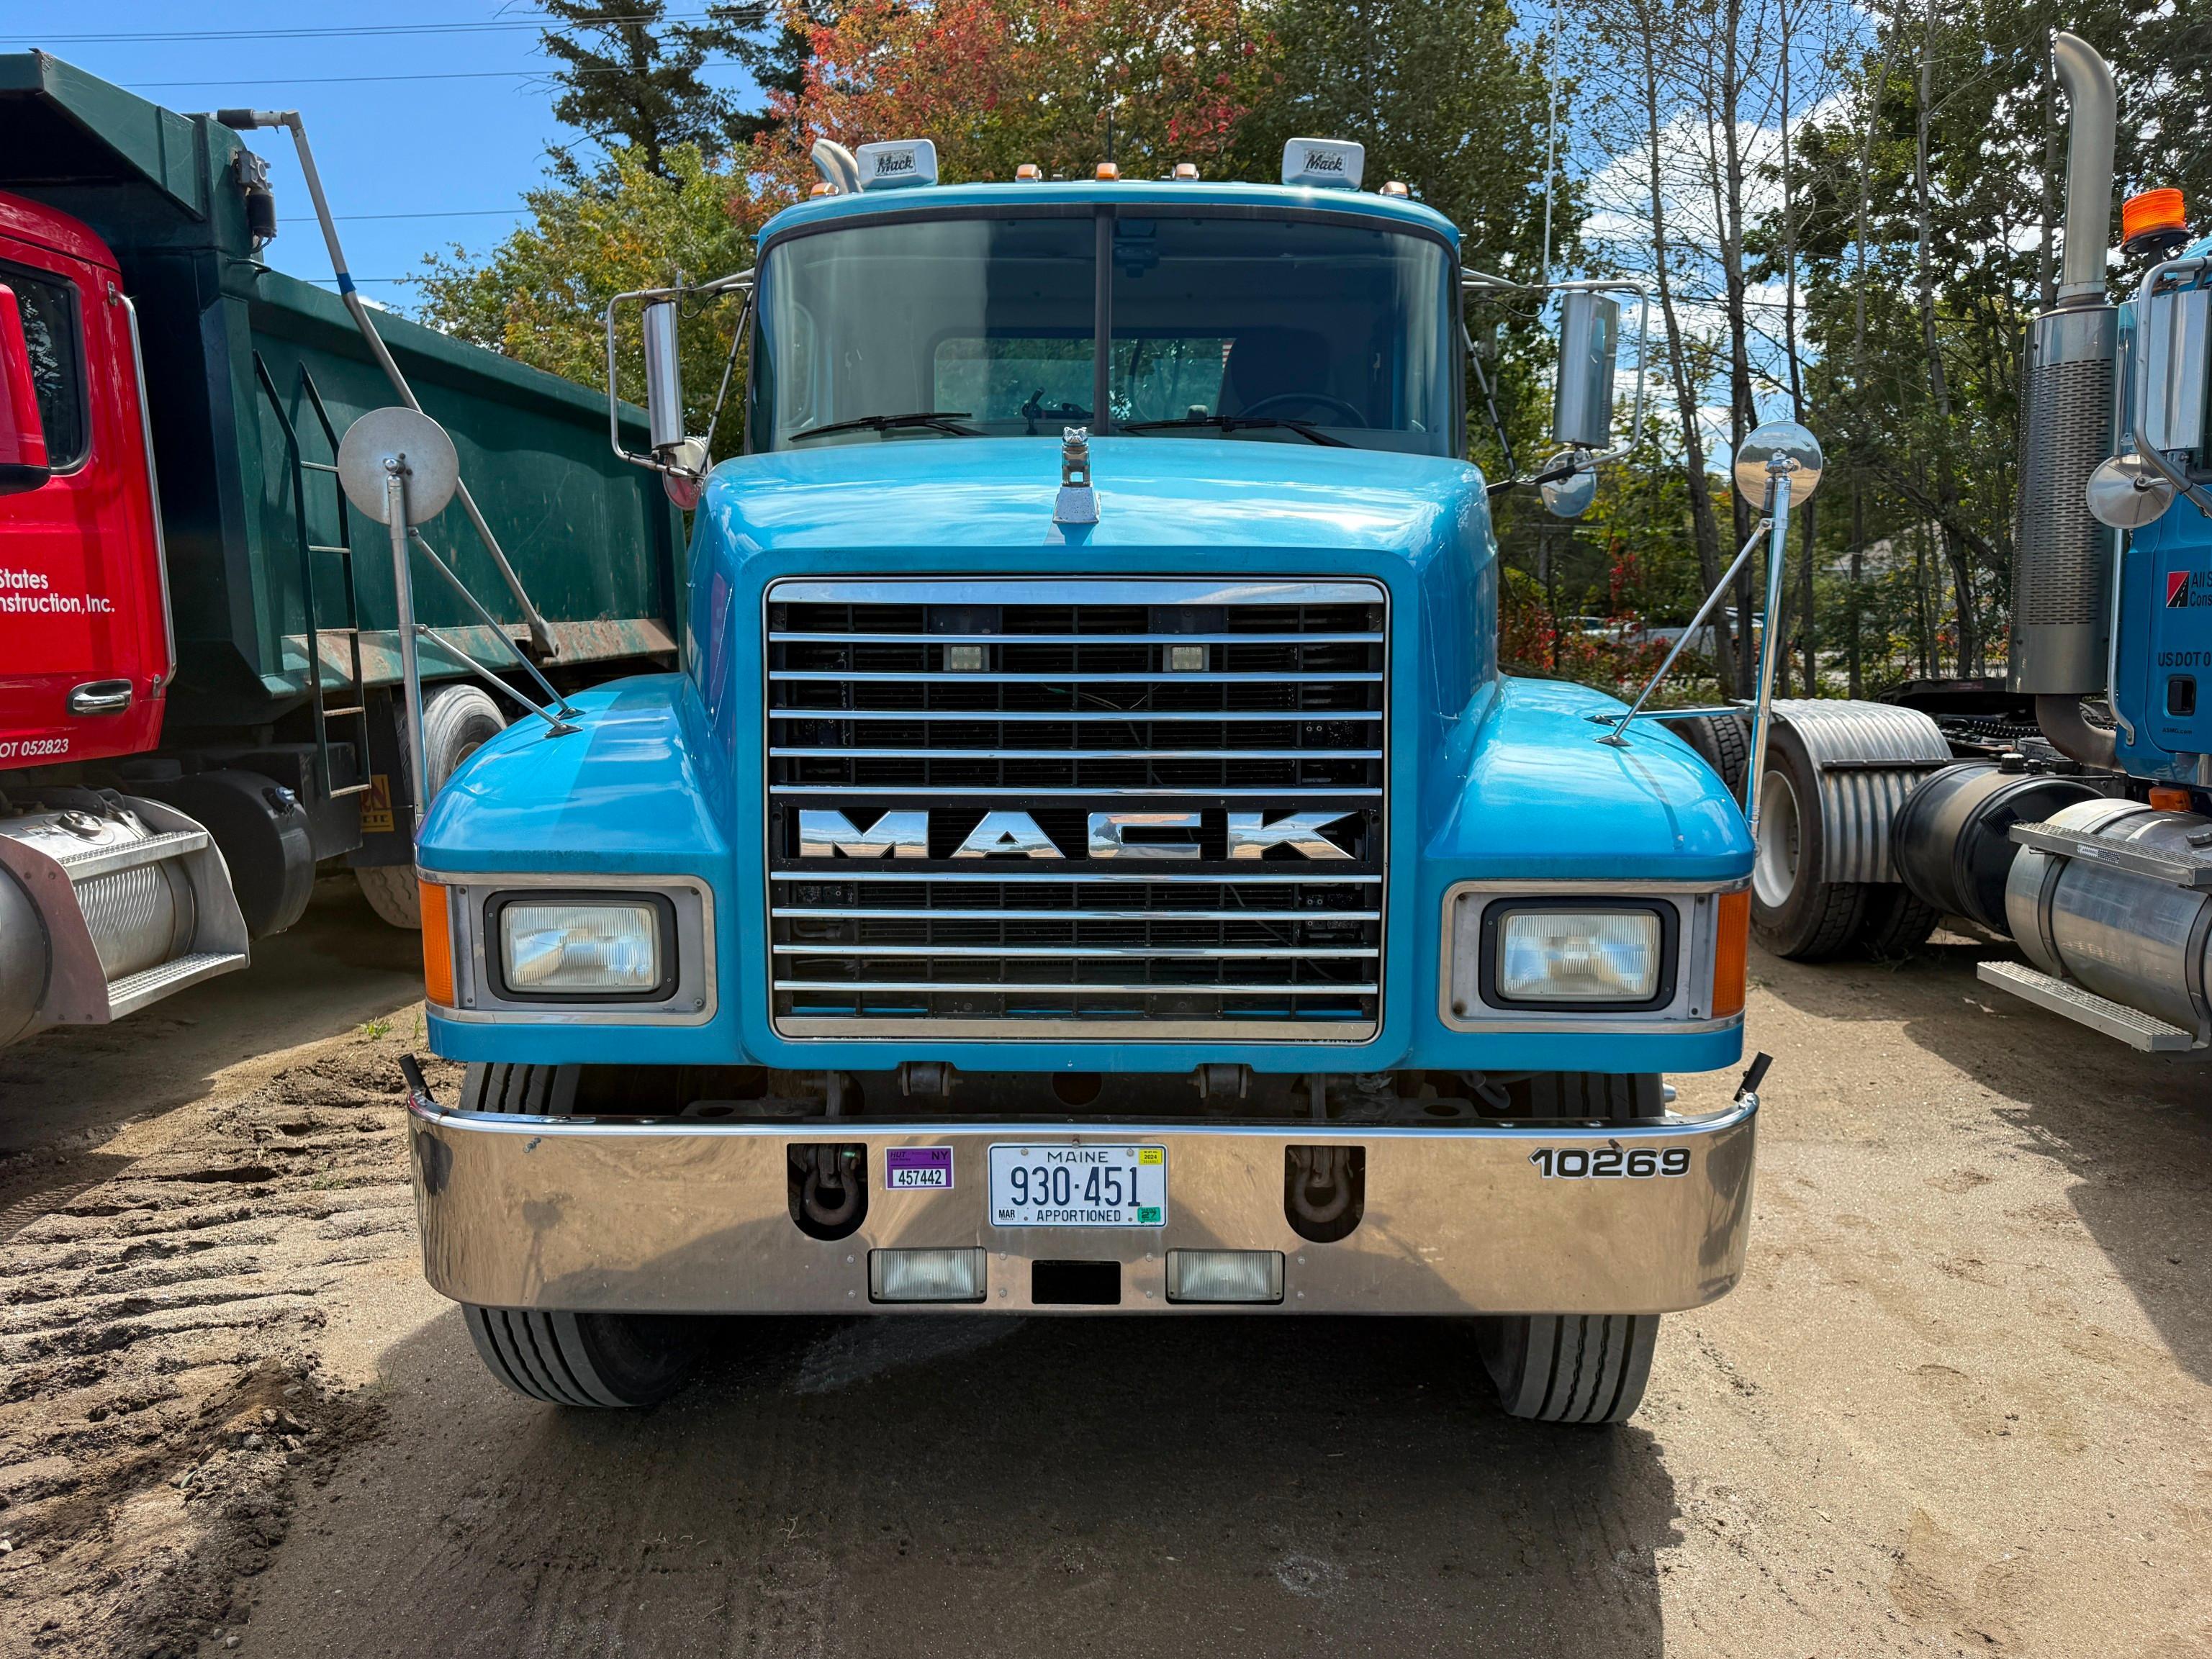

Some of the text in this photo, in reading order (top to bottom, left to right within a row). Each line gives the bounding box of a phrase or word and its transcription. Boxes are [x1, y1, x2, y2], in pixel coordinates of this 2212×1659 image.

[877, 155, 913, 173] Mack
[1306, 154, 1342, 171] Mack
[2191, 571, 2205, 587] All
[86, 594, 115, 612] Inc.
[21, 738, 69, 756] 052823
[798, 809, 1358, 860] MACK
[931, 1152, 948, 1160] NY
[1047, 1151, 1109, 1163] MAINE
[1531, 1149, 1691, 1177] 10269
[898, 1170, 942, 1185] 457442
[998, 1209, 1015, 1219] MAR
[1037, 1209, 1121, 1222] APPORTIONED
